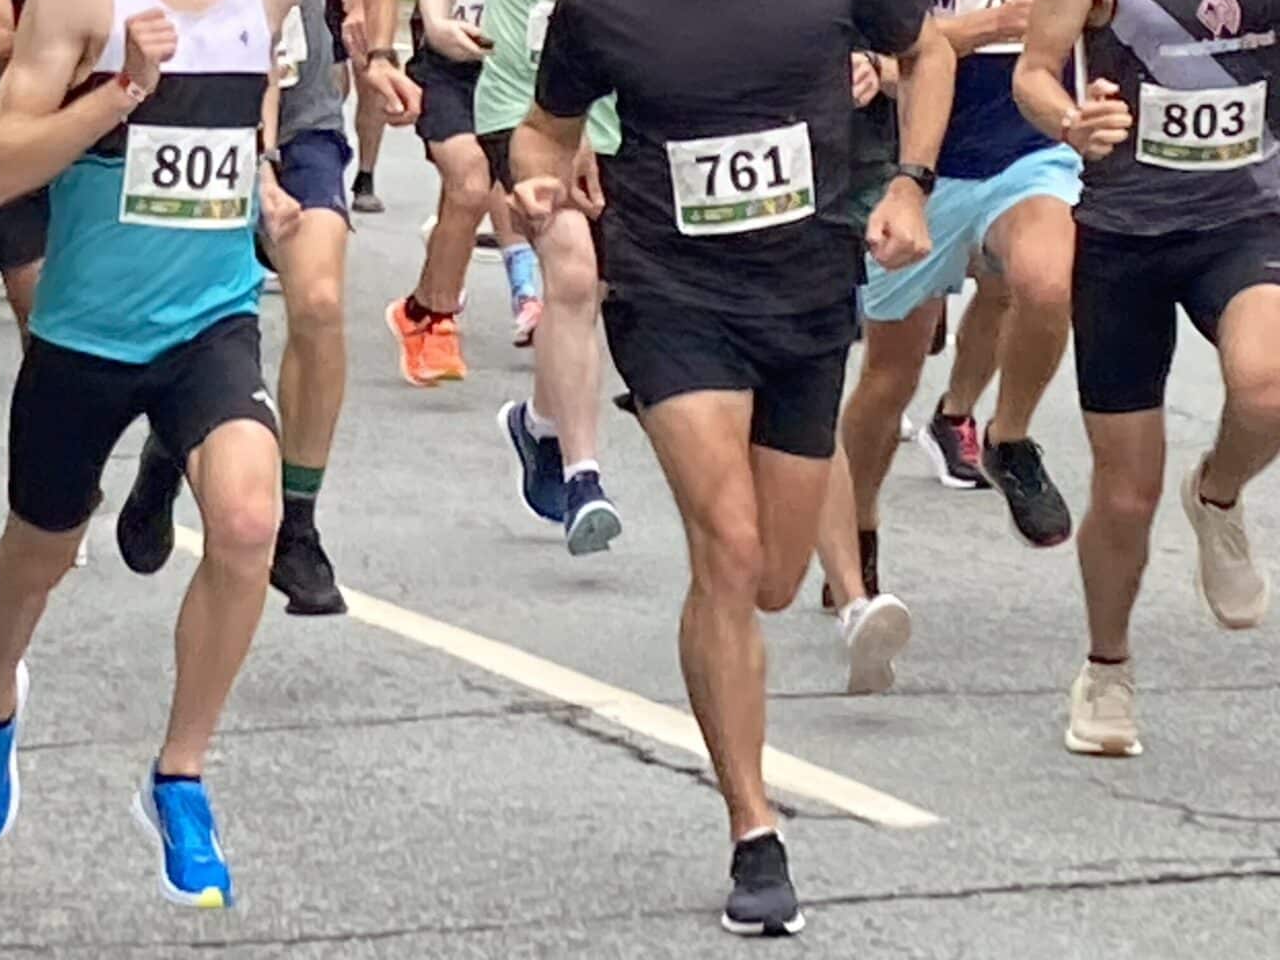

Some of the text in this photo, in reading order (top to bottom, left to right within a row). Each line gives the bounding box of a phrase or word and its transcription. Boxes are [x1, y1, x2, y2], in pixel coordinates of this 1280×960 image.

[1162, 101, 1245, 139] 803
[152, 145, 240, 190] 804
[695, 146, 791, 196] 761
